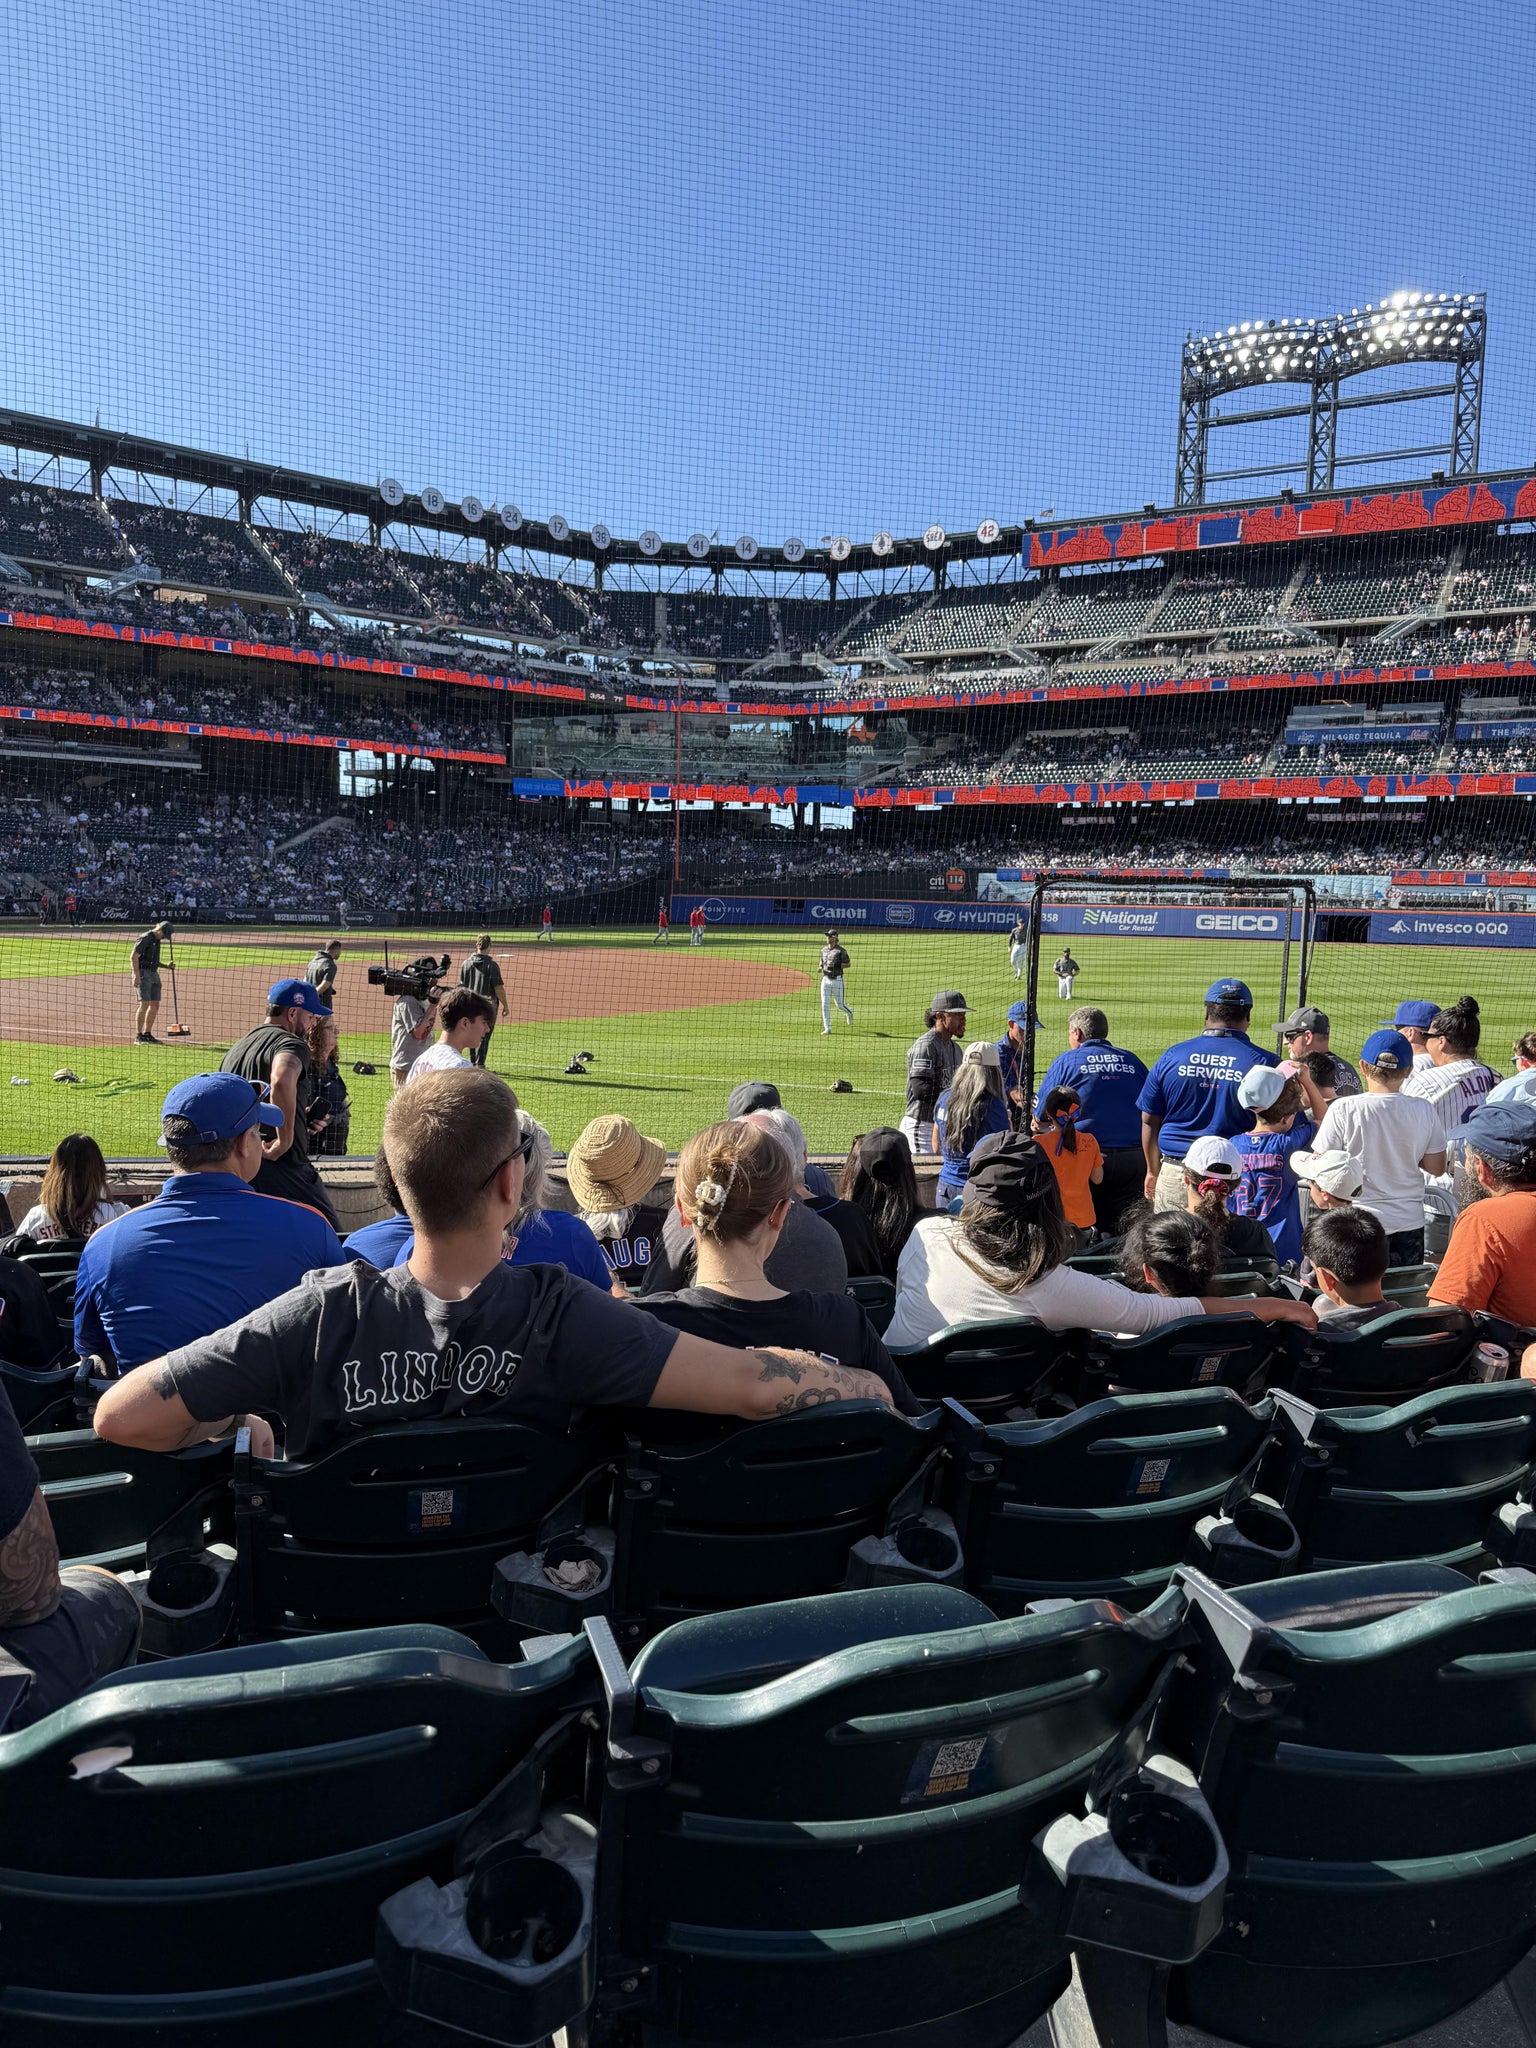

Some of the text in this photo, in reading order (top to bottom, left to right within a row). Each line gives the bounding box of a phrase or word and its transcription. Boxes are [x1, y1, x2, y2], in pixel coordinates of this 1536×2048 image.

[388, 486, 396, 498] 5
[427, 494, 438, 507] 18
[467, 503, 478, 515] 16
[505, 511, 518, 523] 24
[554, 522, 564, 534] 17
[980, 525, 994, 537] 42
[926, 532, 943, 542] SHEA
[645, 538, 655, 549] 31
[694, 540, 704, 551] 41
[742, 543, 751, 554] 14
[788, 545, 800, 555] 37
[1322, 732, 1360, 741] MILAGRO
[1364, 732, 1401, 740] TEQUILA
[930, 876, 945, 886] citi
[100, 907, 130, 919] Ford
[811, 905, 866, 919] Canon
[960, 911, 1020, 924] HYUNDAI
[1042, 913, 1059, 922] 358
[1196, 914, 1278, 932] GEICO
[1414, 920, 1508, 935] Invesco QQQ
[1086, 1054, 1125, 1063] GUEST
[1189, 1053, 1236, 1067] GUEST
[1080, 1064, 1135, 1074] SERVICES
[1178, 1065, 1243, 1082] SERVICES
[1460, 1074, 1502, 1098] ALON
[1240, 1154, 1283, 1172] ENTOS
[1236, 1177, 1283, 1217] 27
[342, 1341, 522, 1412] LINDOR
